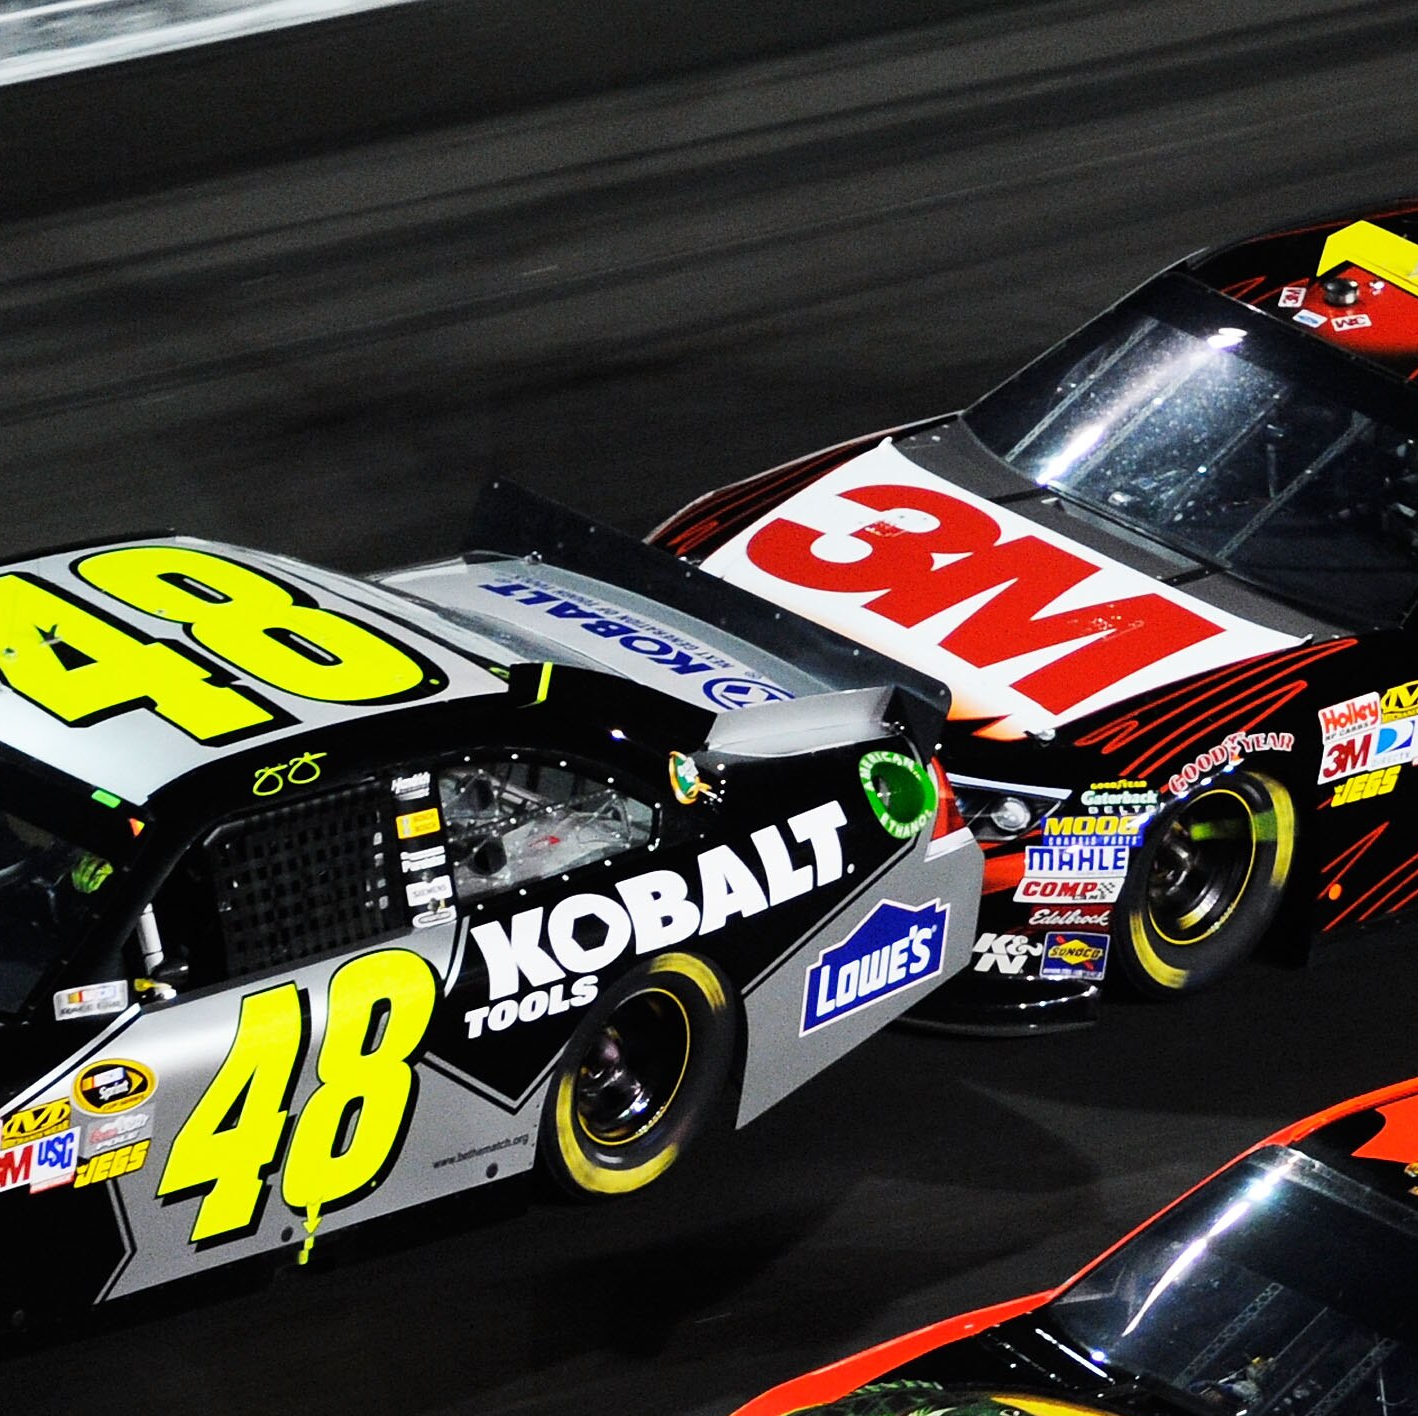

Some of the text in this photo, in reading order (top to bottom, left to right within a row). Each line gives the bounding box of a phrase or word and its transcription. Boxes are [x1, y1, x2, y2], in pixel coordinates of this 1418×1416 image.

[747, 485, 1225, 715] 3M
[479, 582, 713, 675] KOBALT
[1322, 700, 1378, 735] Holley
[1168, 732, 1295, 796] GOODYEAR
[1323, 733, 1372, 779] 3M
[1331, 766, 1402, 807] JEGS
[1028, 848, 1126, 871] MAHLE
[471, 800, 847, 999] KOBALT
[1023, 881, 1098, 897] COMP
[1029, 908, 1111, 927] Edelbrock
[816, 924, 934, 1018] LOWE'S
[1049, 946, 1102, 959] SUNOCO
[465, 976, 599, 1038] TOOLS
[157, 949, 437, 1243] 48
[37, 1131, 75, 1169] USG
[74, 1138, 152, 1189] JEGS
